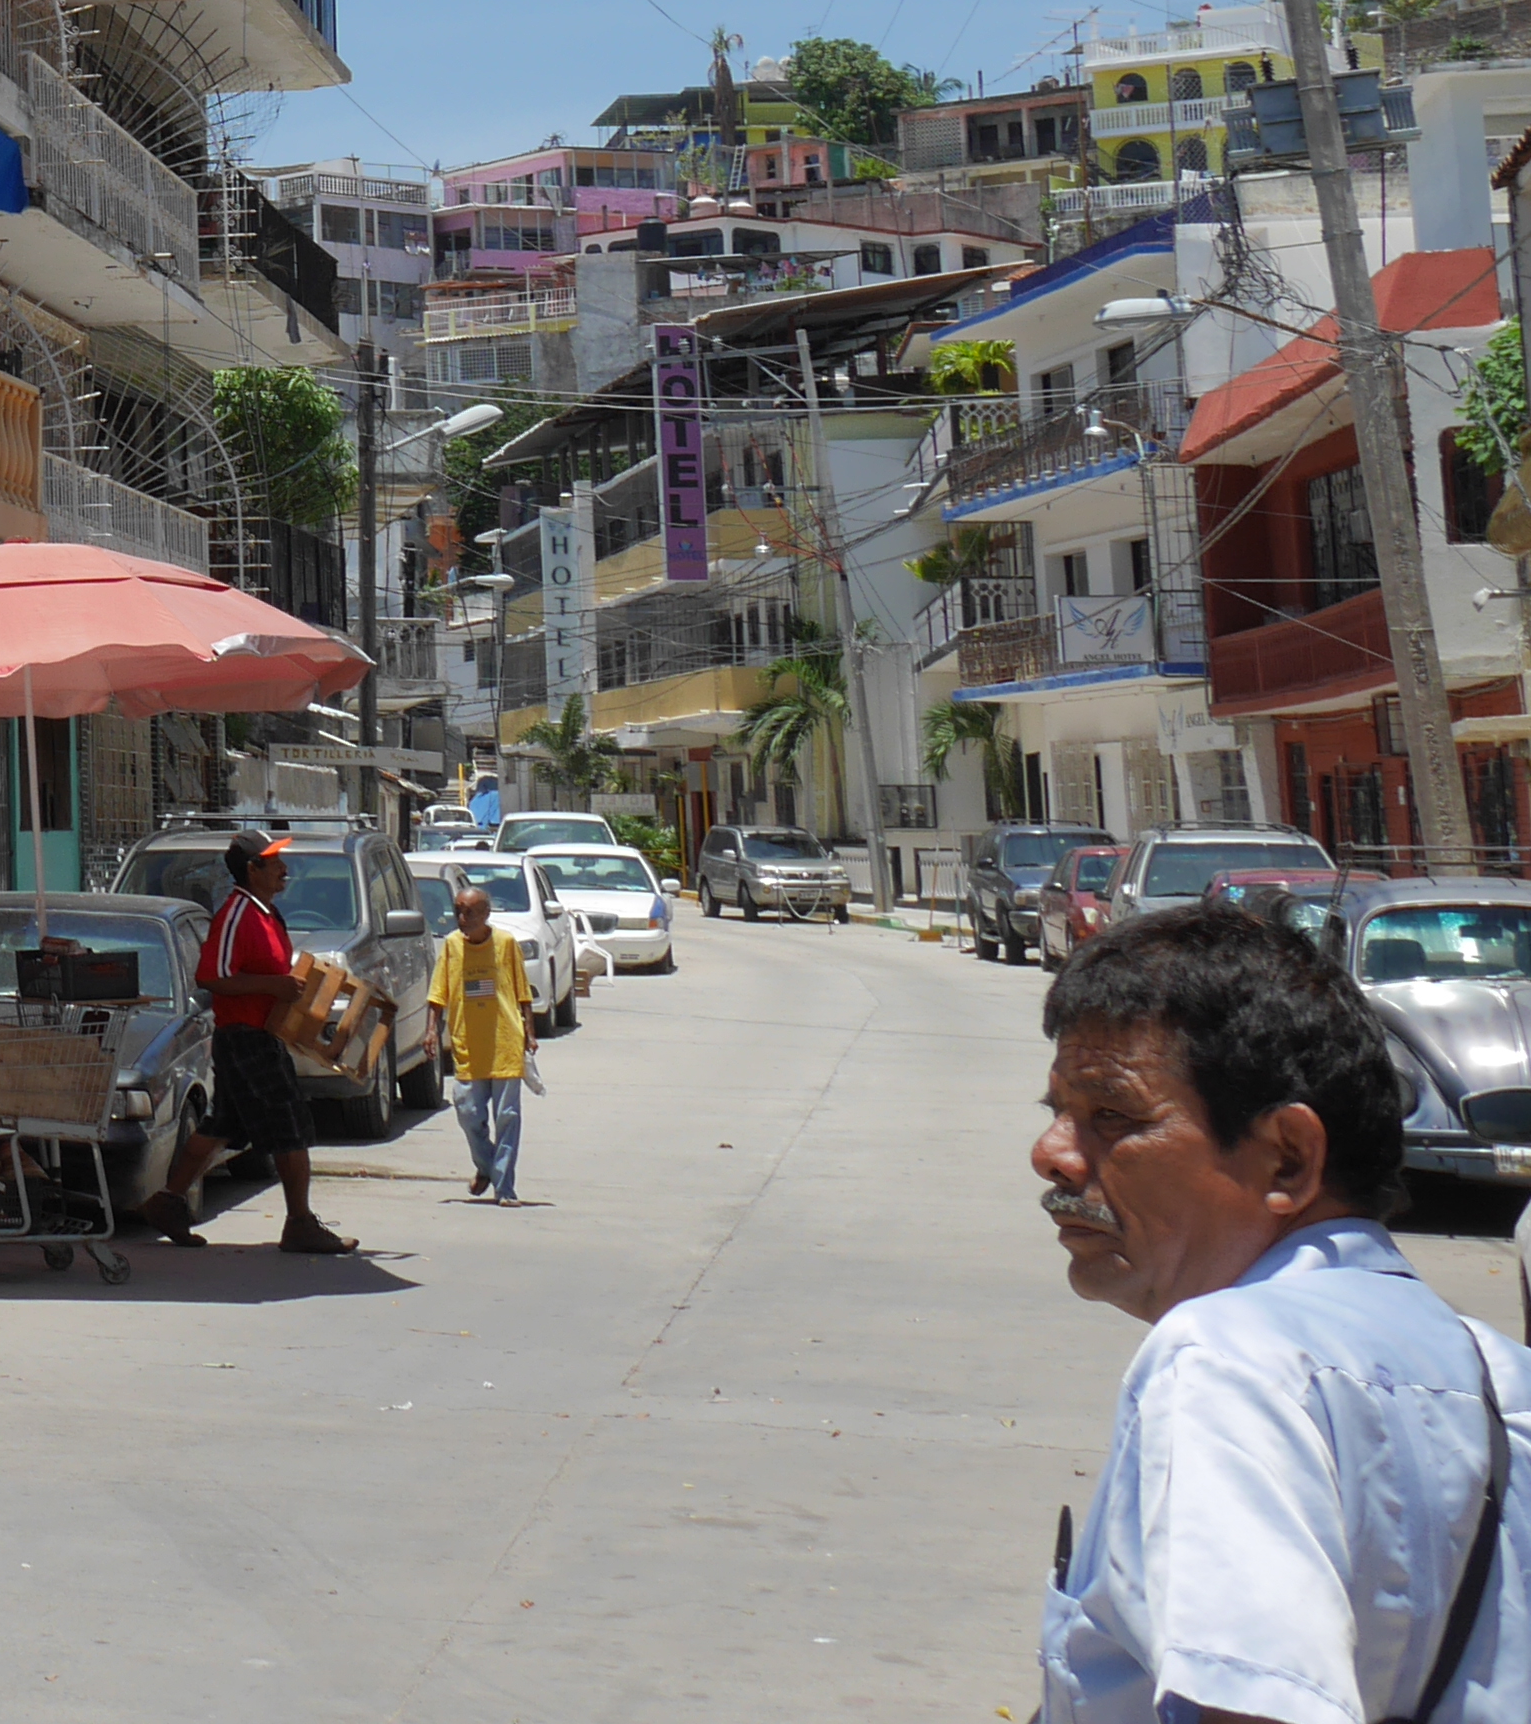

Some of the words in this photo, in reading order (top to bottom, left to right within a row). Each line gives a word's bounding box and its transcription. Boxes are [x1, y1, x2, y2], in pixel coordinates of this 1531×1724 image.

[658, 335, 699, 529] HOTEL
[551, 535, 572, 678] HOTEL
[1083, 653, 1111, 661] ANGEL
[1114, 653, 1143, 661] HOTEL
[280, 746, 376, 761] TORTILLERIA
